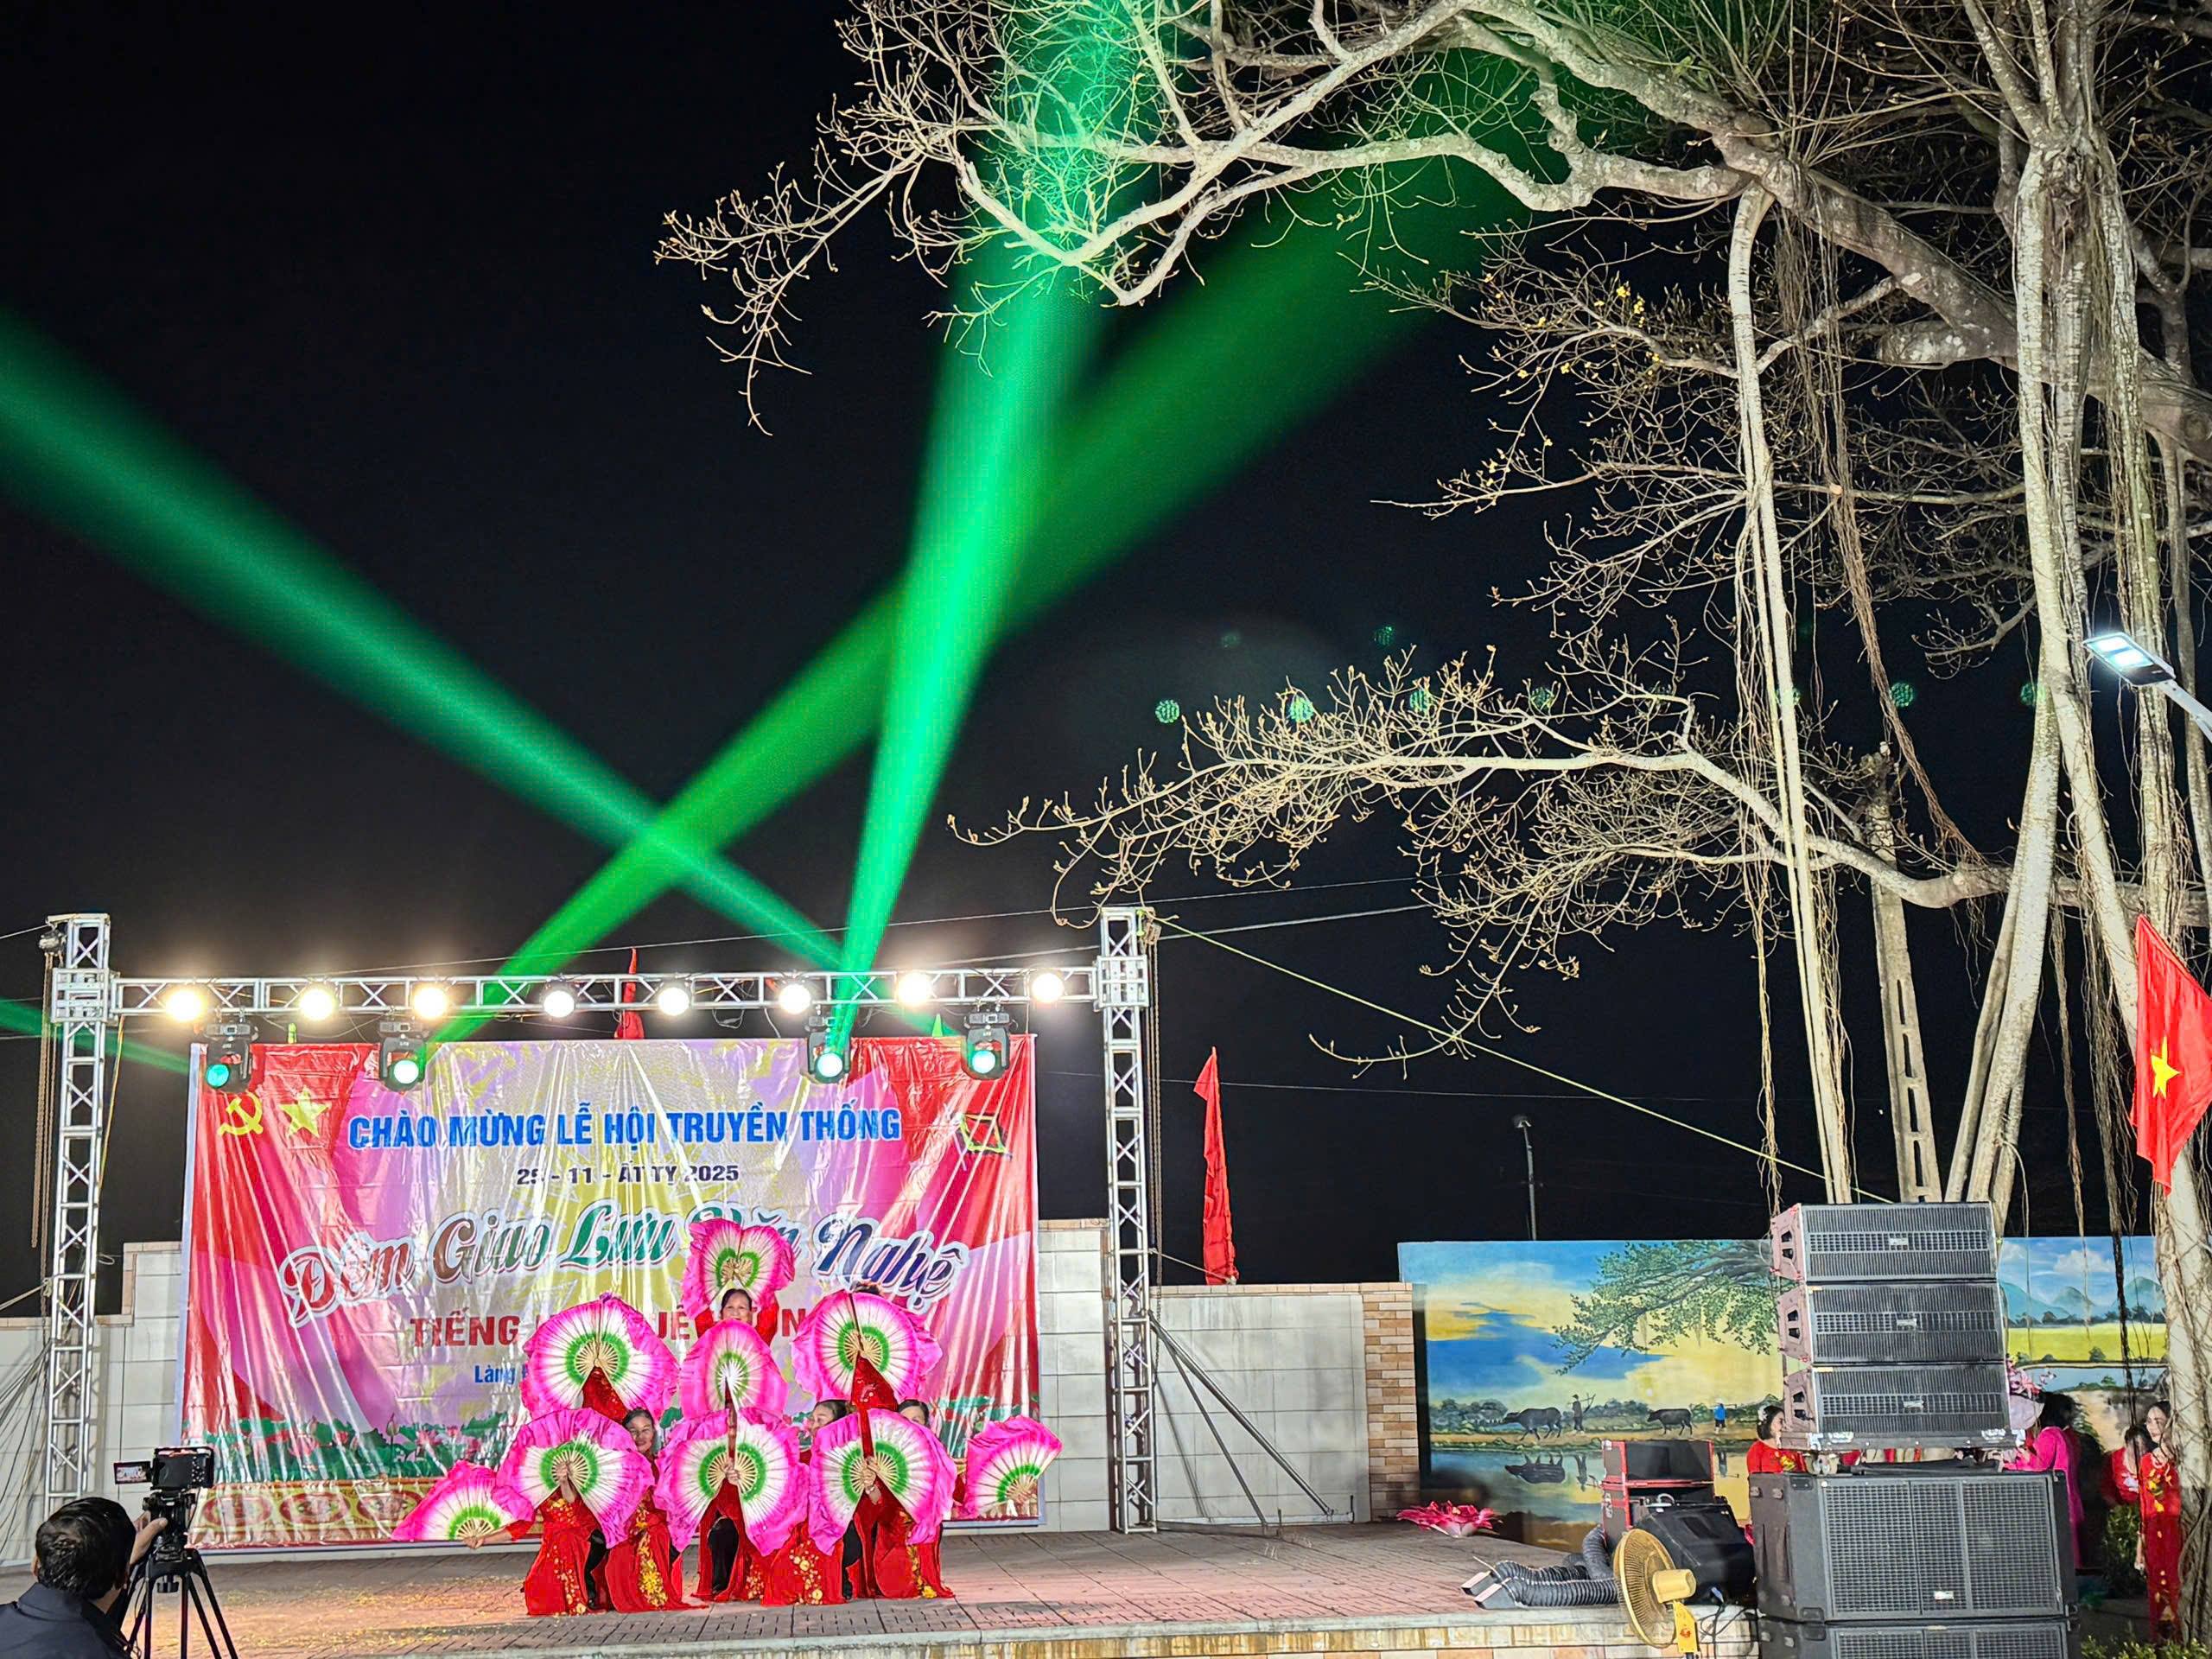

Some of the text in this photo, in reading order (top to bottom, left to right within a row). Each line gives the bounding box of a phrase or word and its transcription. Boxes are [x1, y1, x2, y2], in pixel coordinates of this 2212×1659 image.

[349, 1099, 902, 1151] CHÀO MỪNG LỄ HỘI TRUYỀN THỐNG
[569, 1167, 593, 1184] 11
[684, 1165, 739, 1182] 2025
[432, 1214, 551, 1284] Giao
[559, 1203, 678, 1269] Lưu
[817, 1217, 964, 1309] Nghệ
[410, 1306, 520, 1347] TIẾNG
[474, 1363, 516, 1385] Làng
